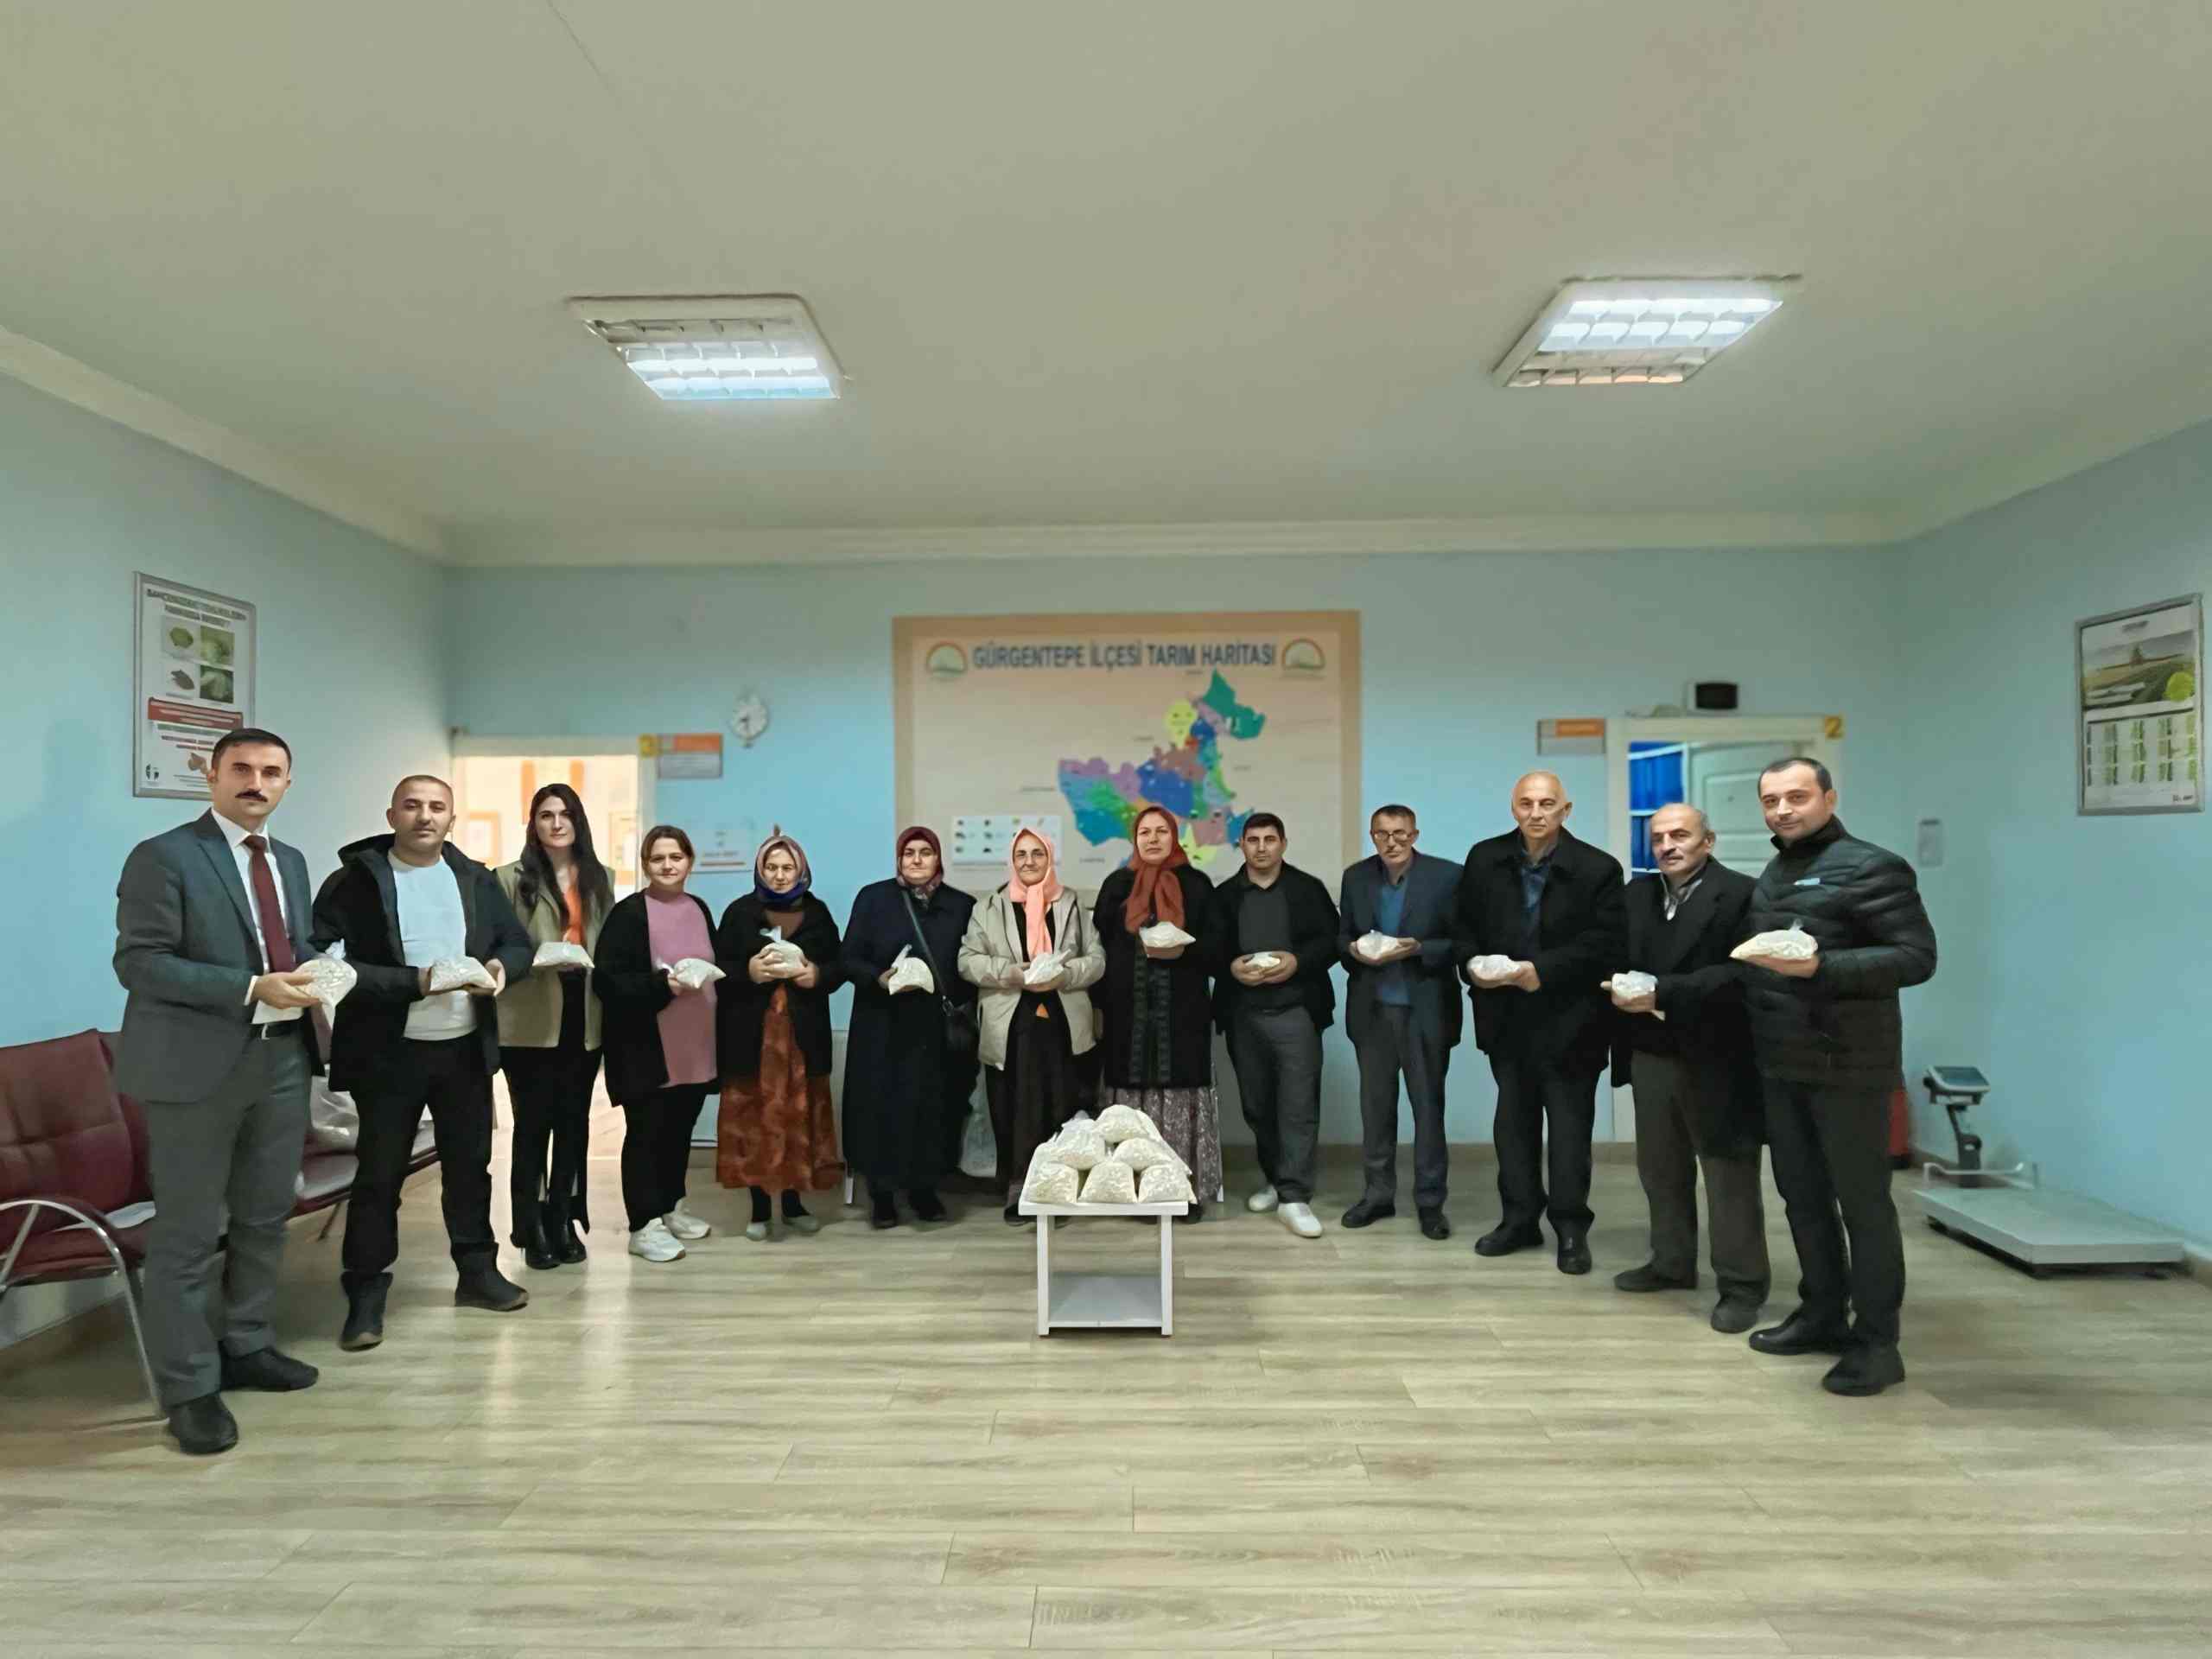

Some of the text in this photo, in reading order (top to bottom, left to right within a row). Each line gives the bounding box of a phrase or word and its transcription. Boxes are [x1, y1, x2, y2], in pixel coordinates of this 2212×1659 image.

[973, 639, 1276, 675] GÜRGENTEPE İLÇESİ TARIM HARİTASI
